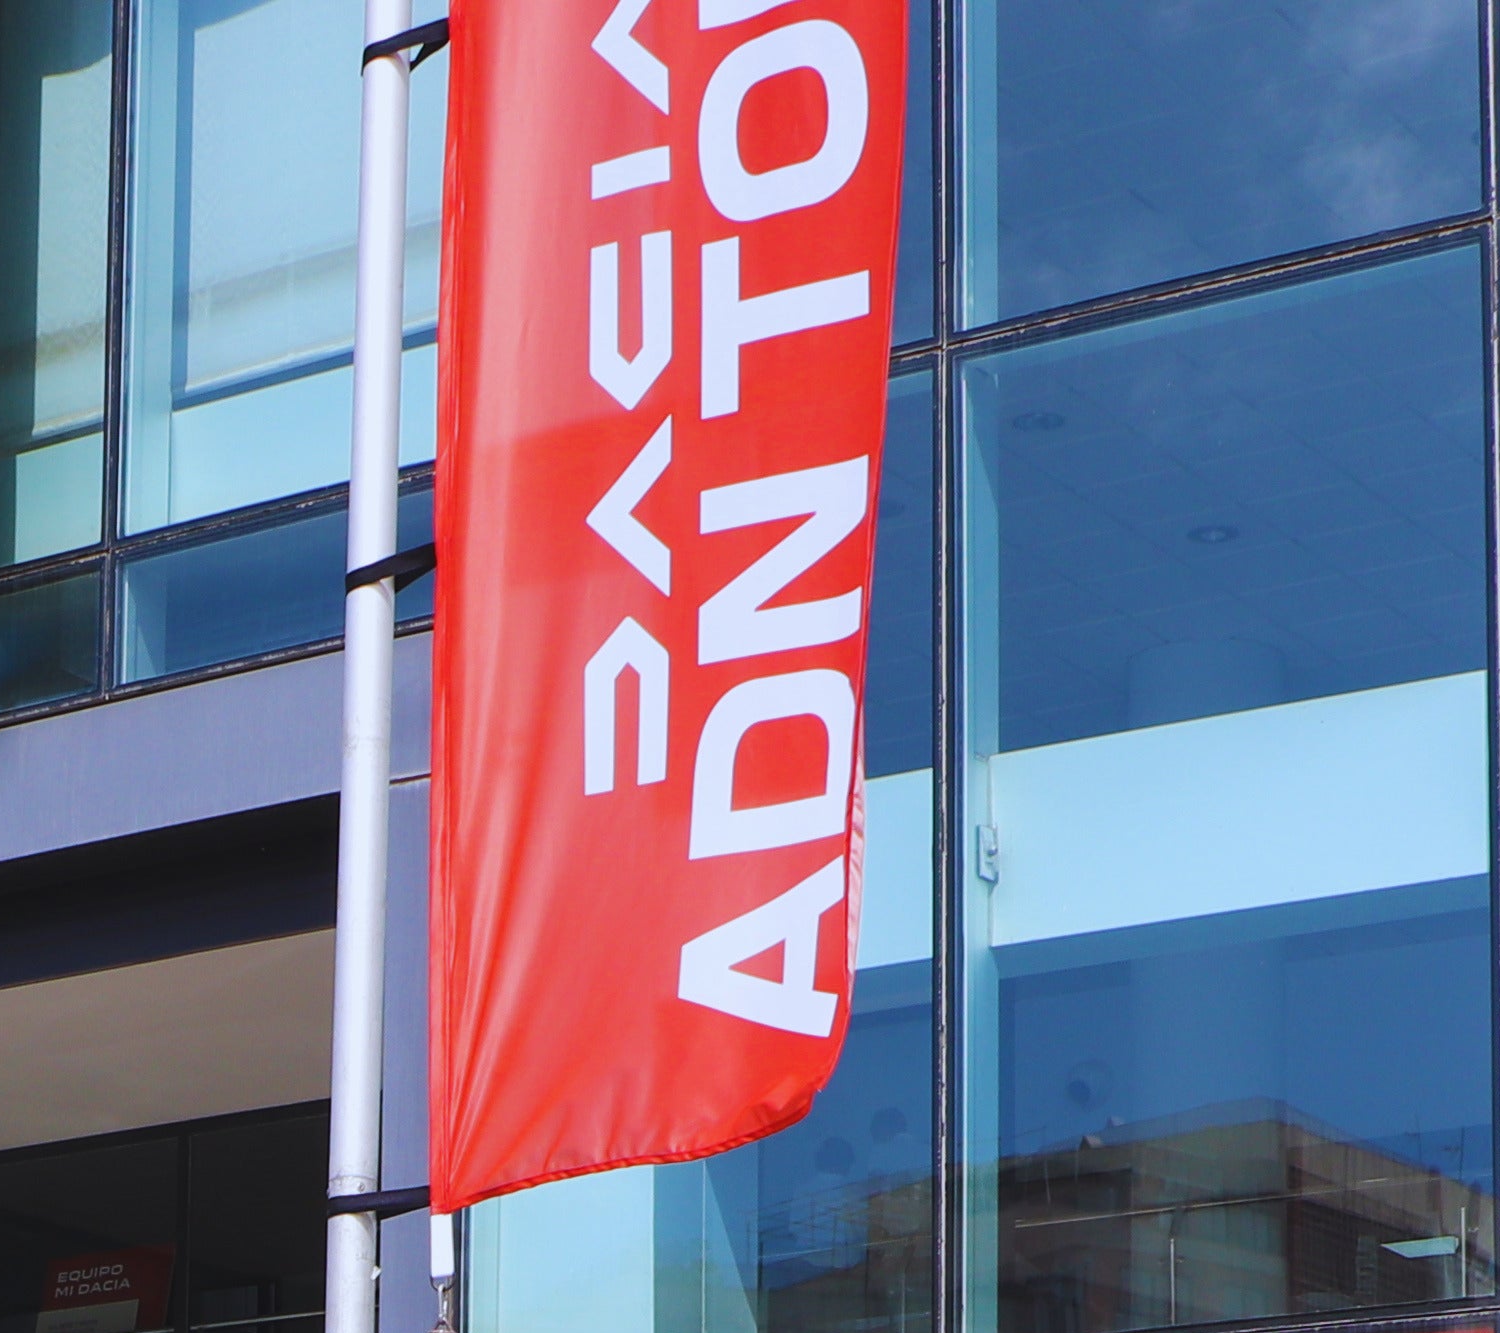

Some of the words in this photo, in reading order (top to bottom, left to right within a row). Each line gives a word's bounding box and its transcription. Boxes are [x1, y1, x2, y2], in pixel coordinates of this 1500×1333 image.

[677, 454, 870, 1038] ADN
[57, 1264, 124, 1283] EQUIPO
[55, 1285, 74, 1298] MI
[78, 1278, 131, 1295] DACIA
